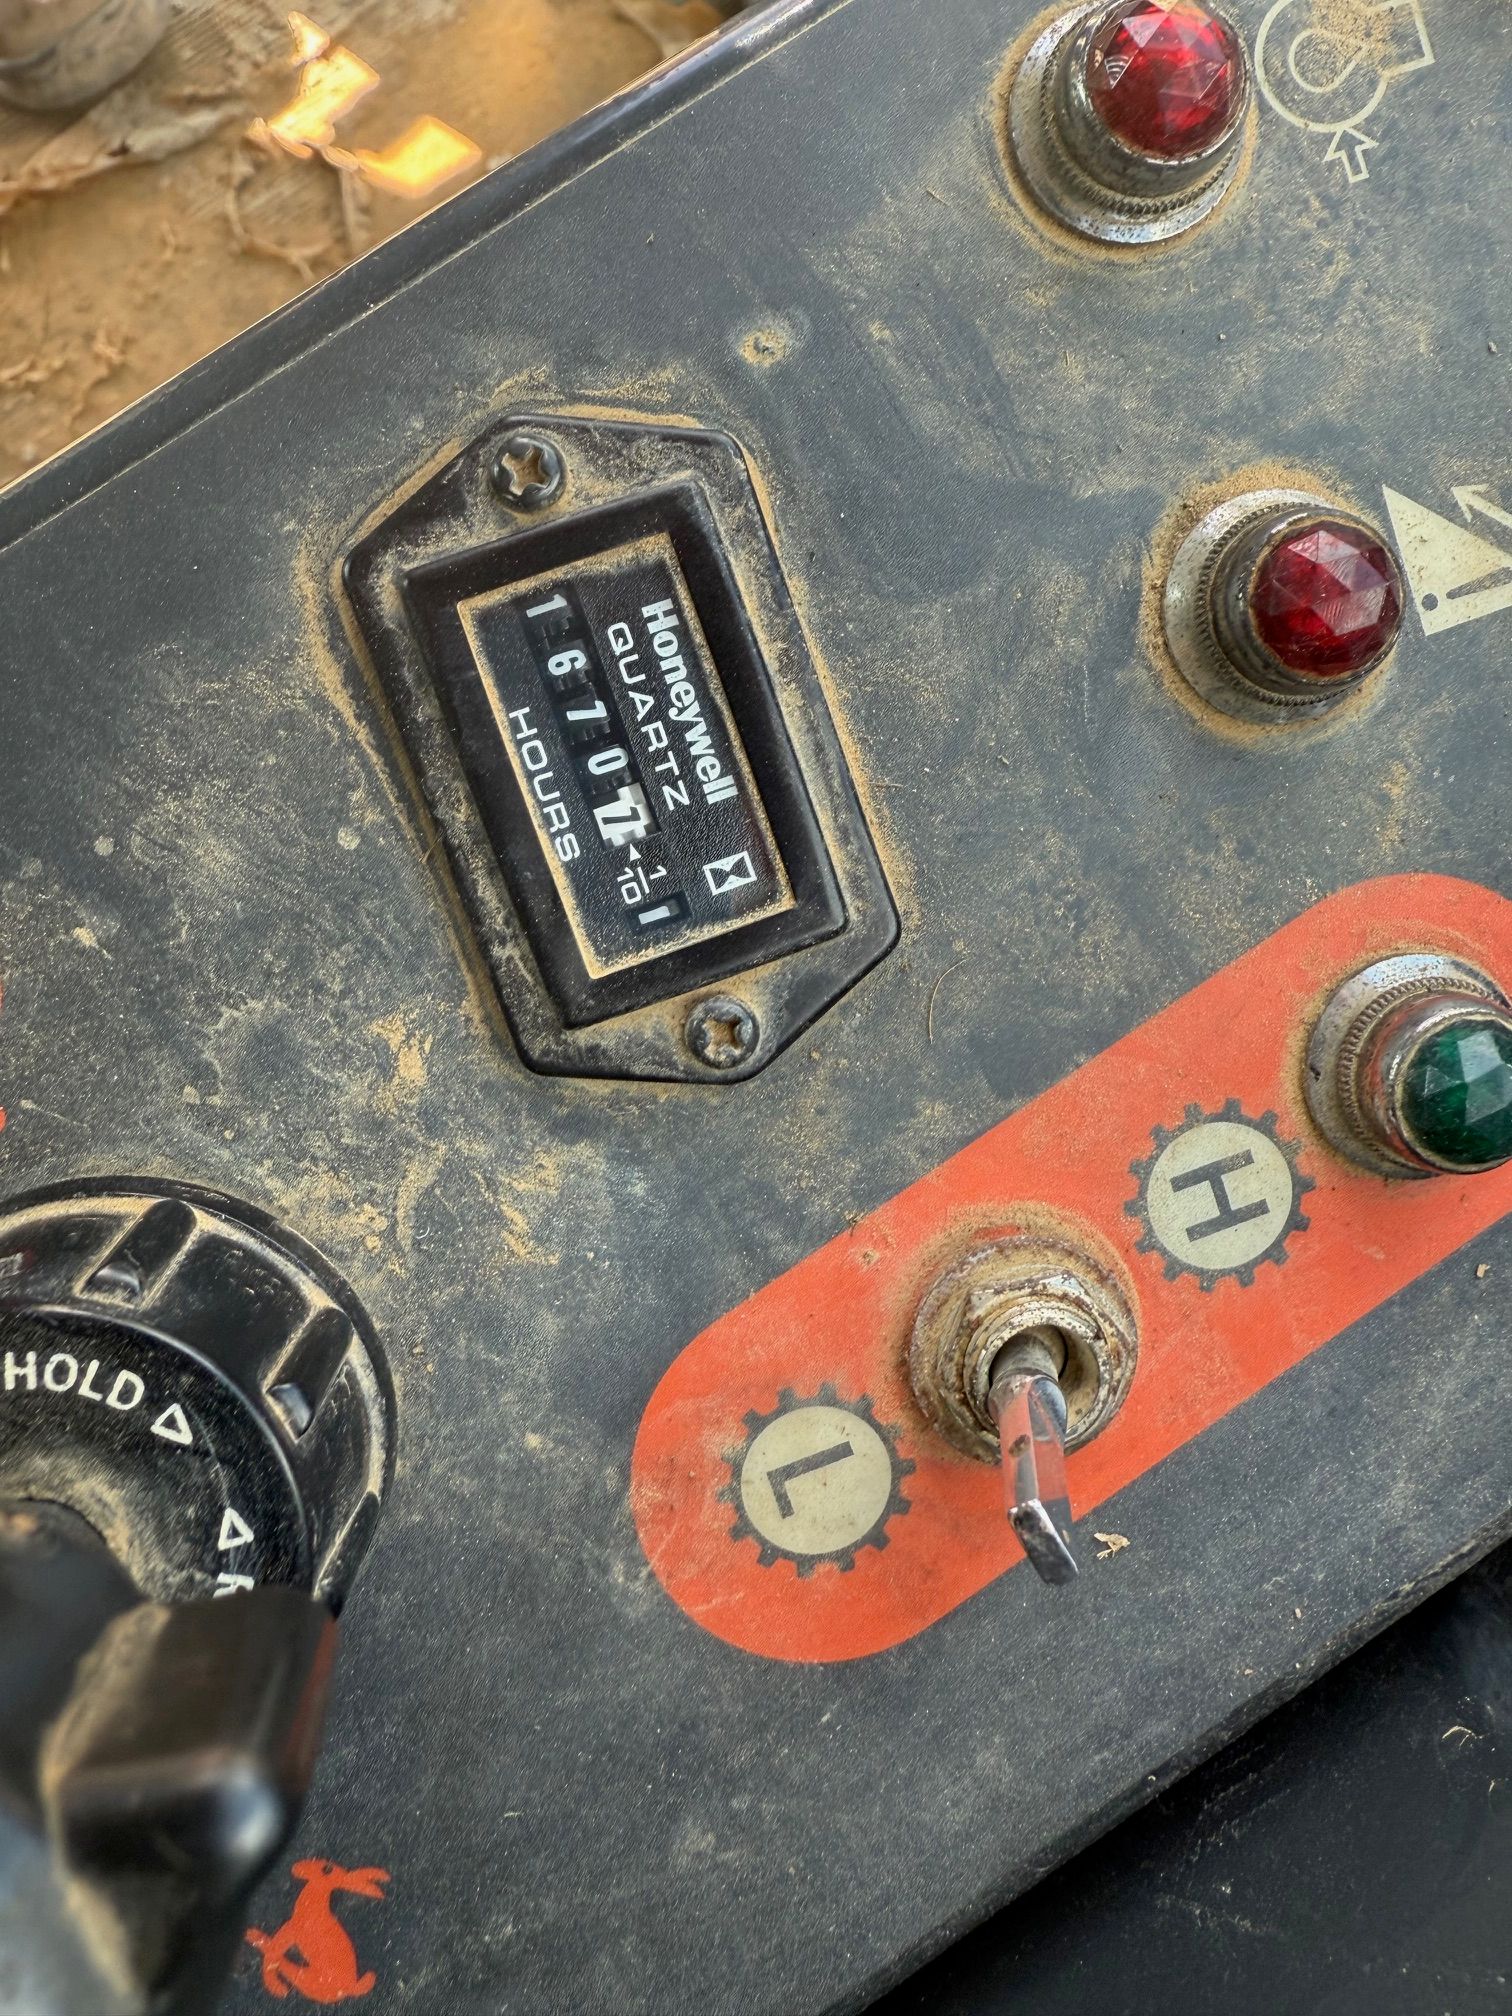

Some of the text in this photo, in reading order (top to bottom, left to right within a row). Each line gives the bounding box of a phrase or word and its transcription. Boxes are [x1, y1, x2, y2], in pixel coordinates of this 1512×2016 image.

[608, 622, 690, 811] QUARTZ
[641, 598, 739, 805] Honeywell
[508, 706, 581, 863] HOURS
[1170, 1148, 1271, 1243] H
[3, 1351, 145, 1411] HOLD
[766, 1440, 855, 1521] L
